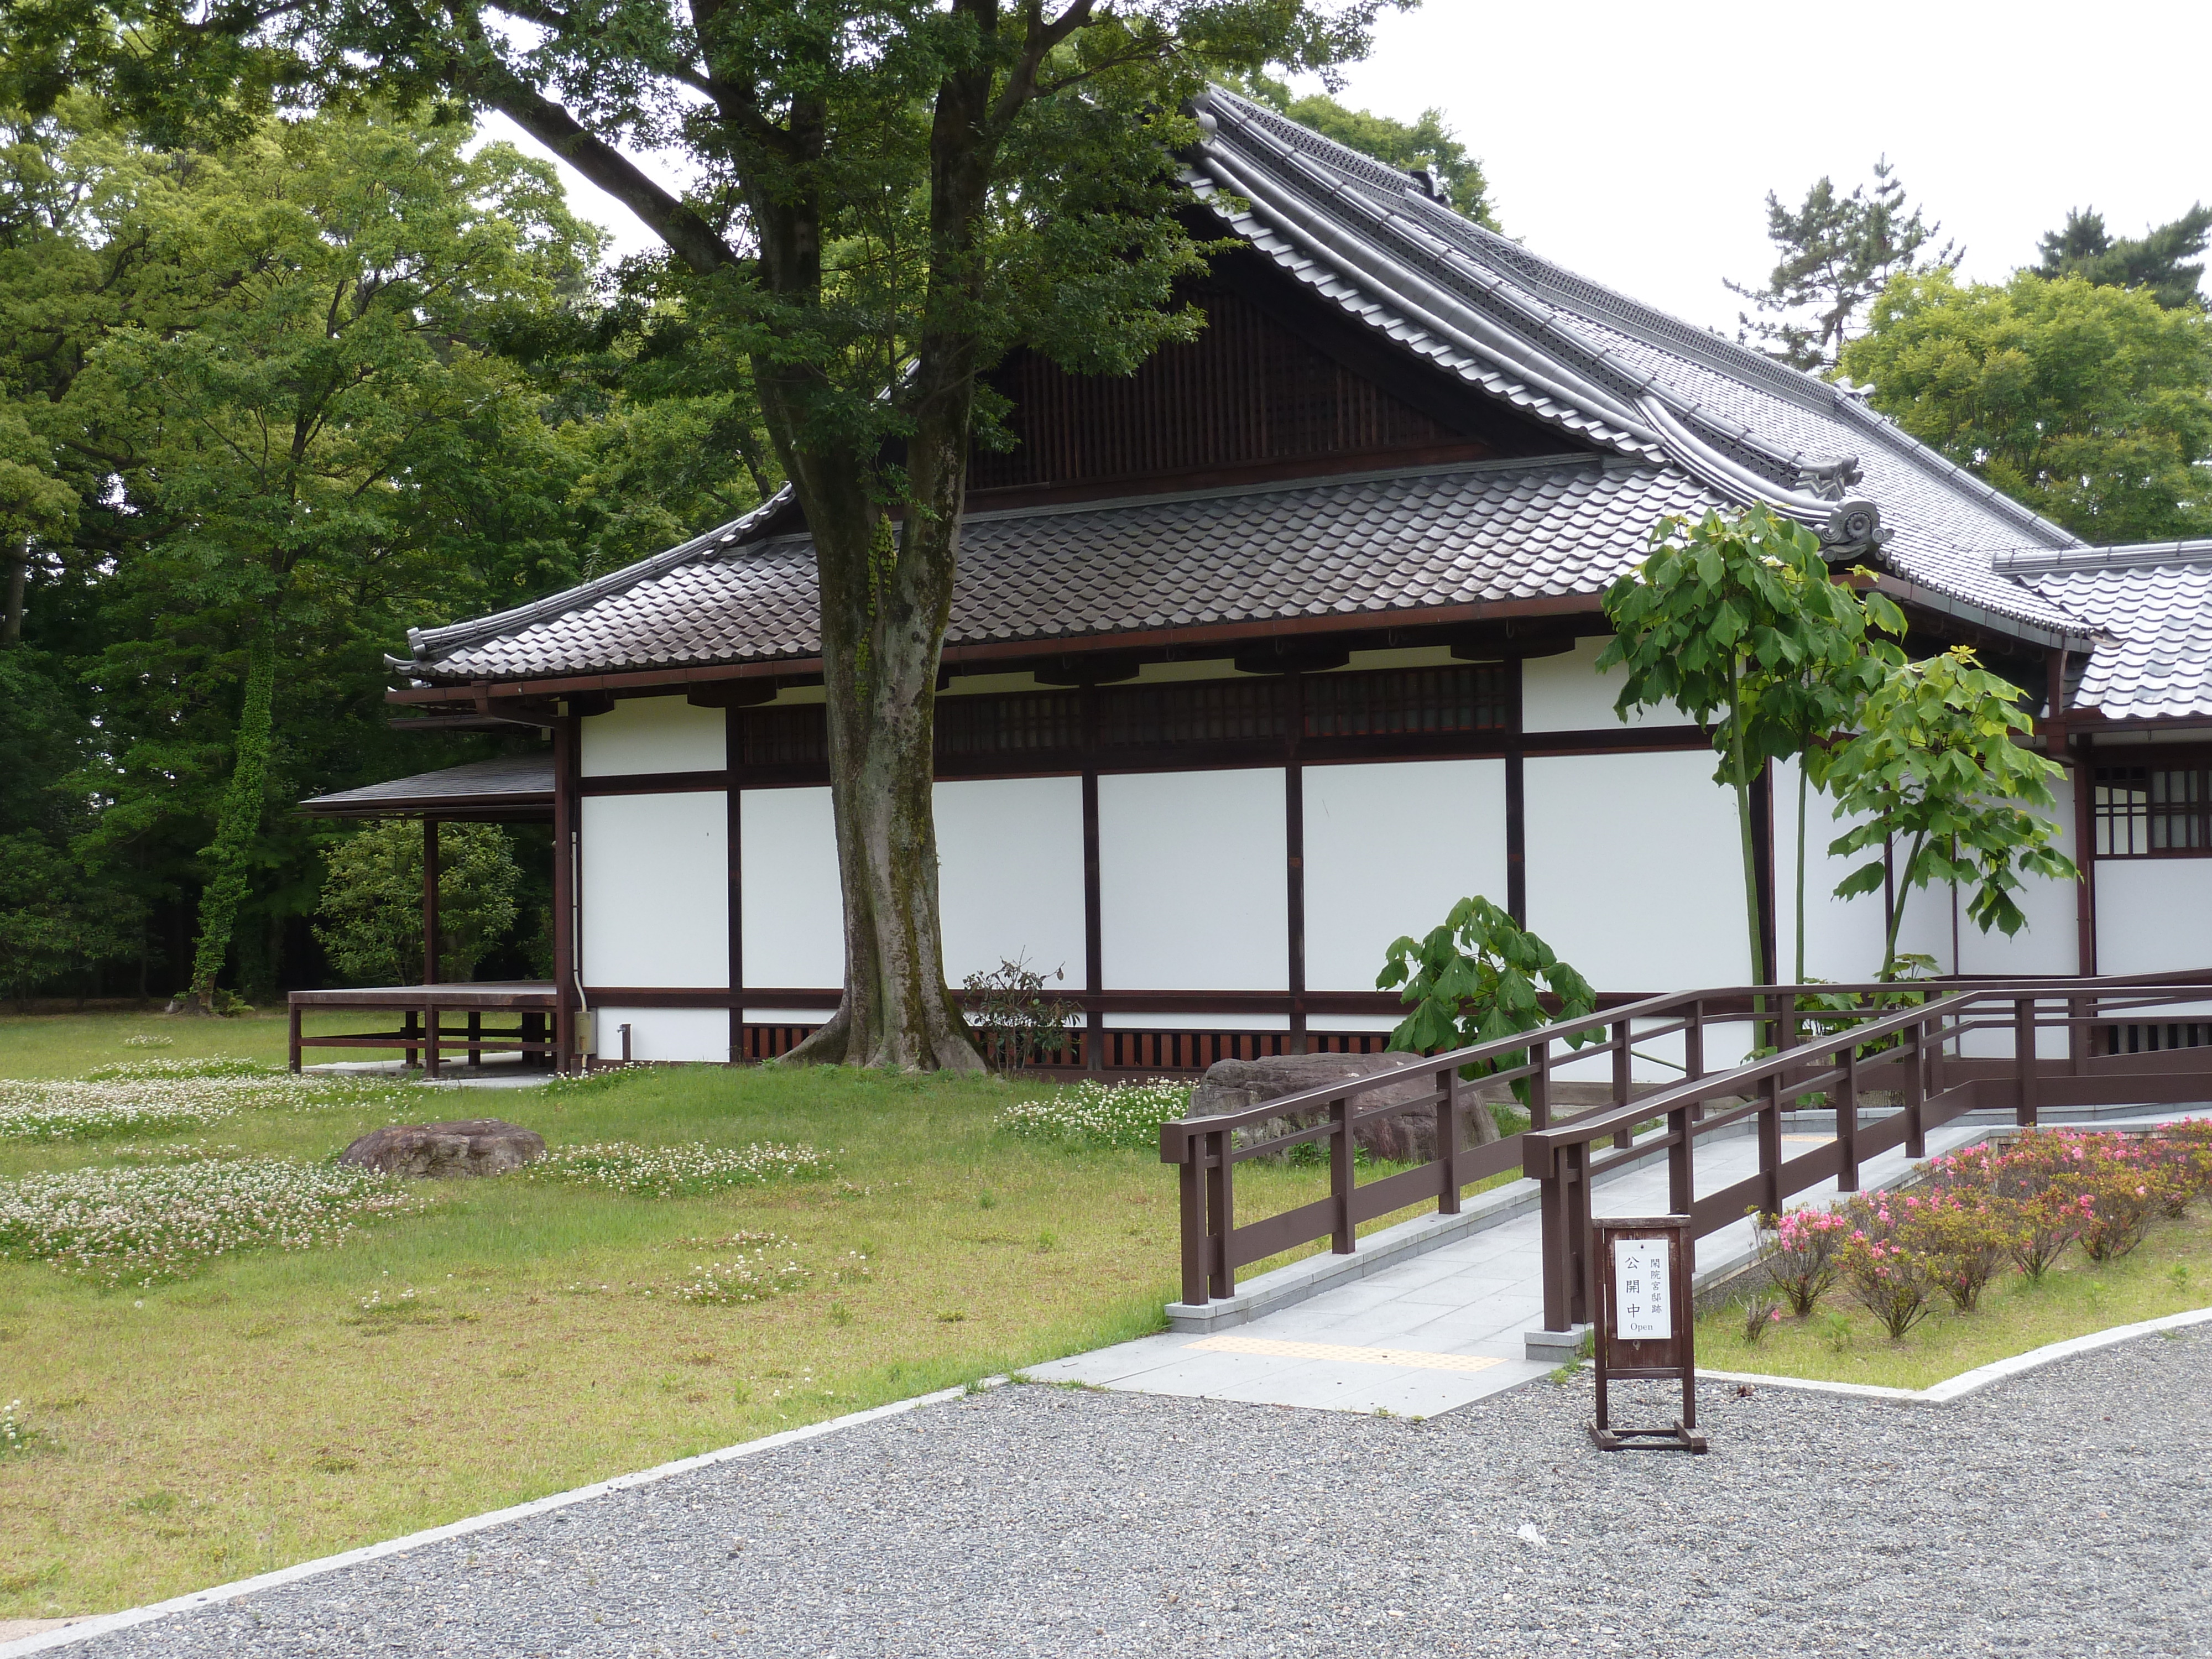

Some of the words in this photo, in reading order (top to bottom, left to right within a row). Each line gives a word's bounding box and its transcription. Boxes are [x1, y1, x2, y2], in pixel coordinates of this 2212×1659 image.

[1625, 1256, 1640, 1318] 公開中
[1650, 1258, 1662, 1313] 閑院宮邸跡
[1630, 1323, 1653, 1332] Open
